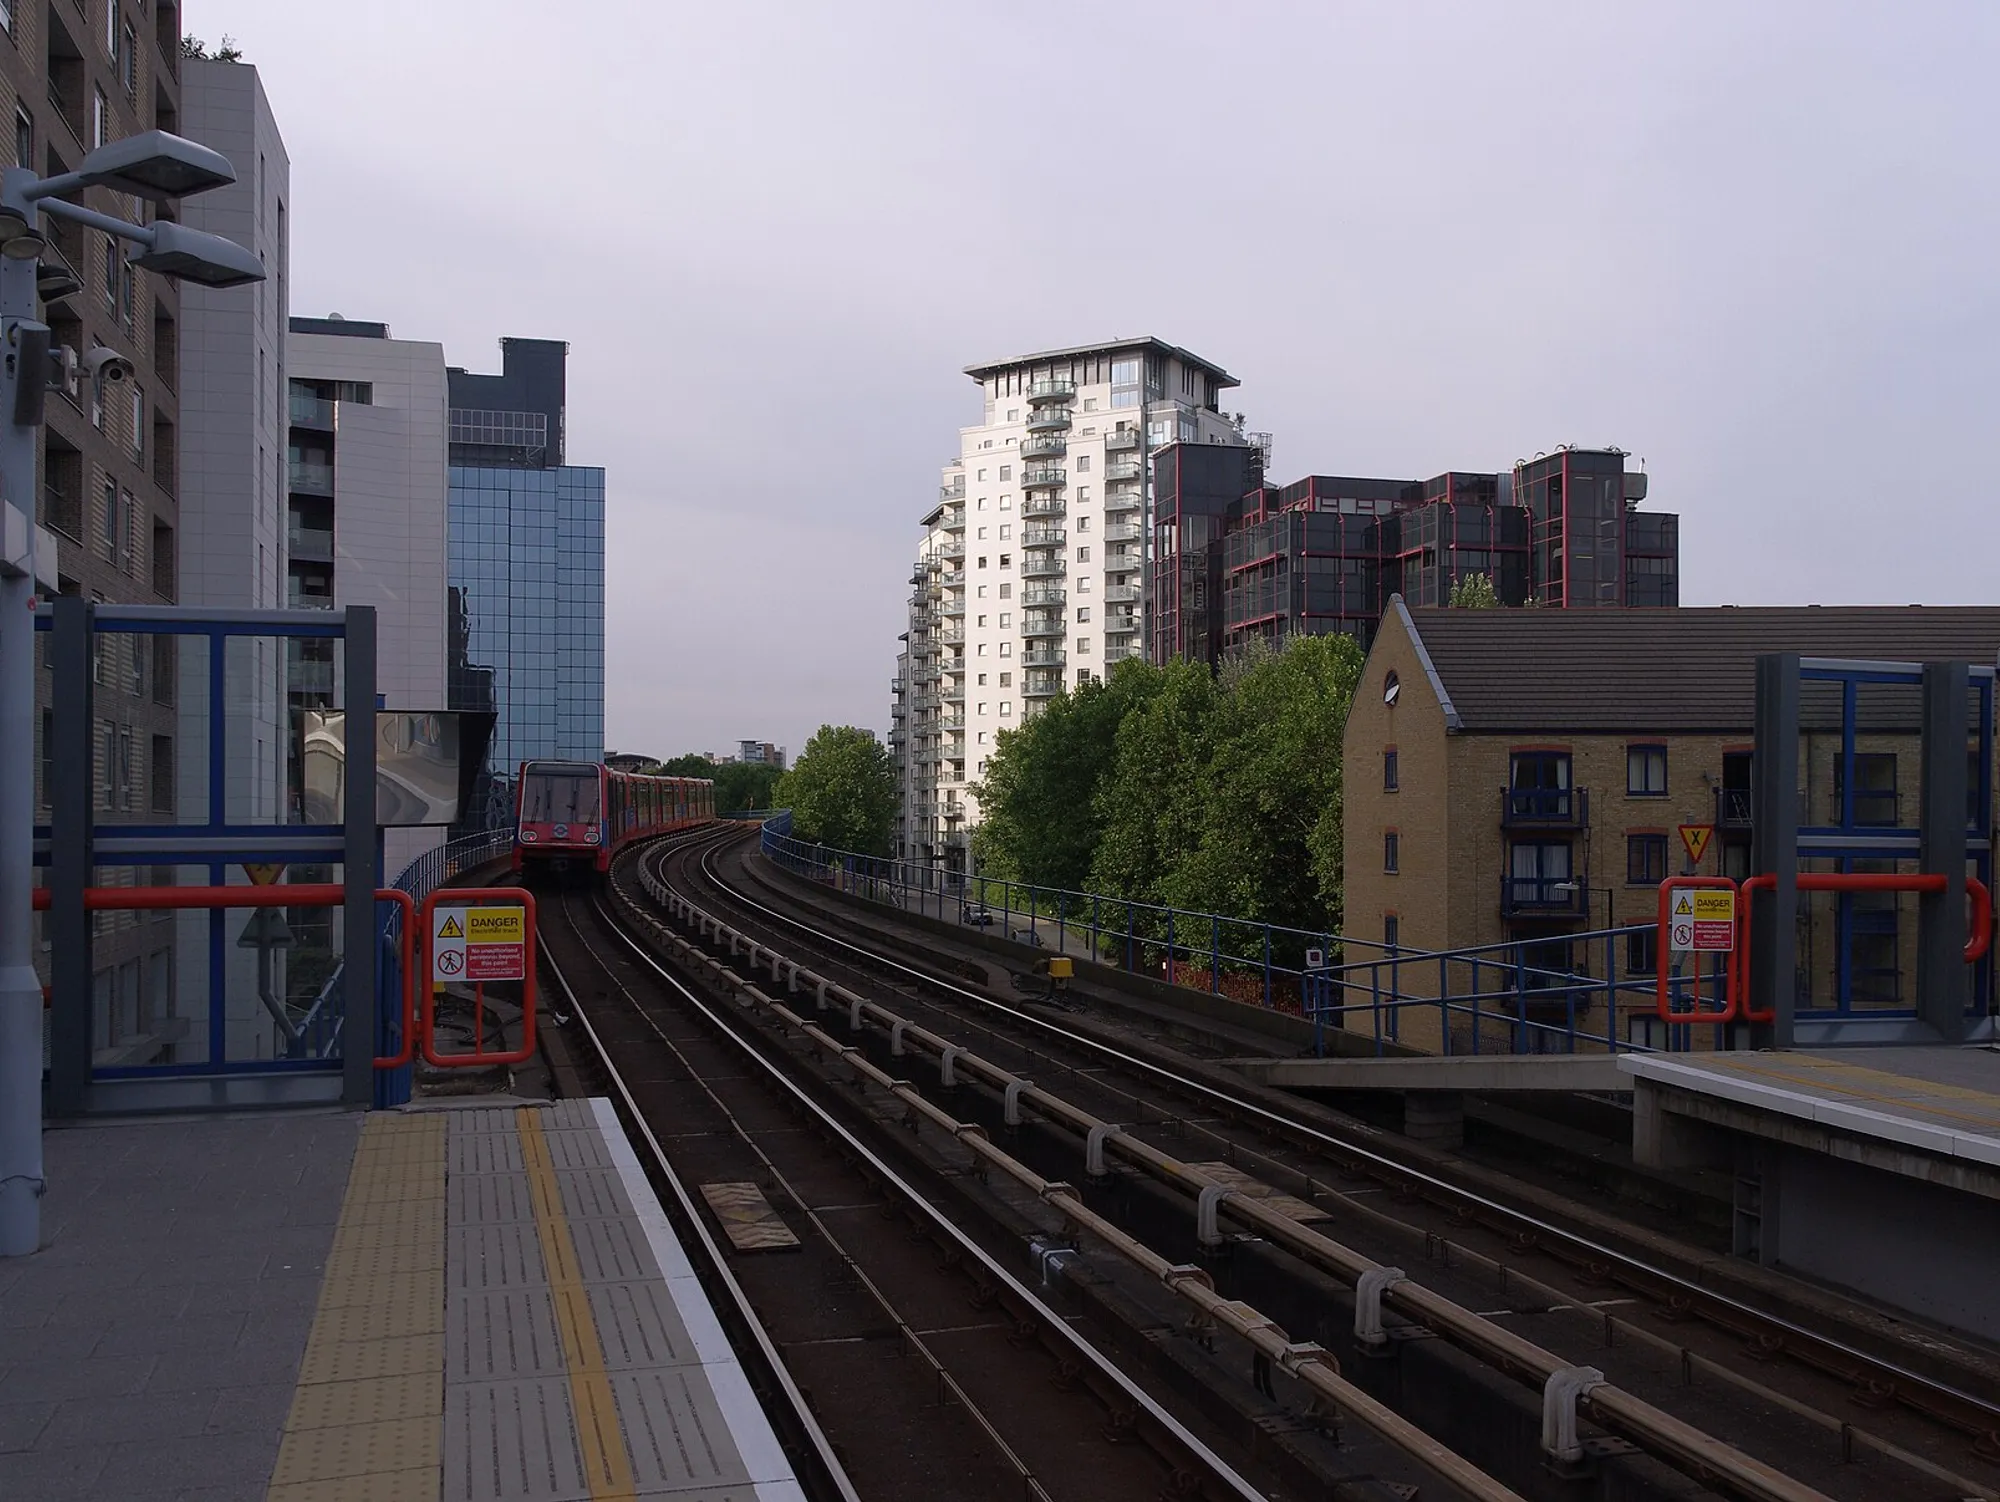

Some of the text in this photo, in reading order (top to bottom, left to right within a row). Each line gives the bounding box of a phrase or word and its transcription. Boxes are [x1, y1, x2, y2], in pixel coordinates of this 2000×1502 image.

[1691, 830, 1701, 845] X
[1697, 899, 1730, 907] DANGER
[471, 917, 518, 927] DANGER
